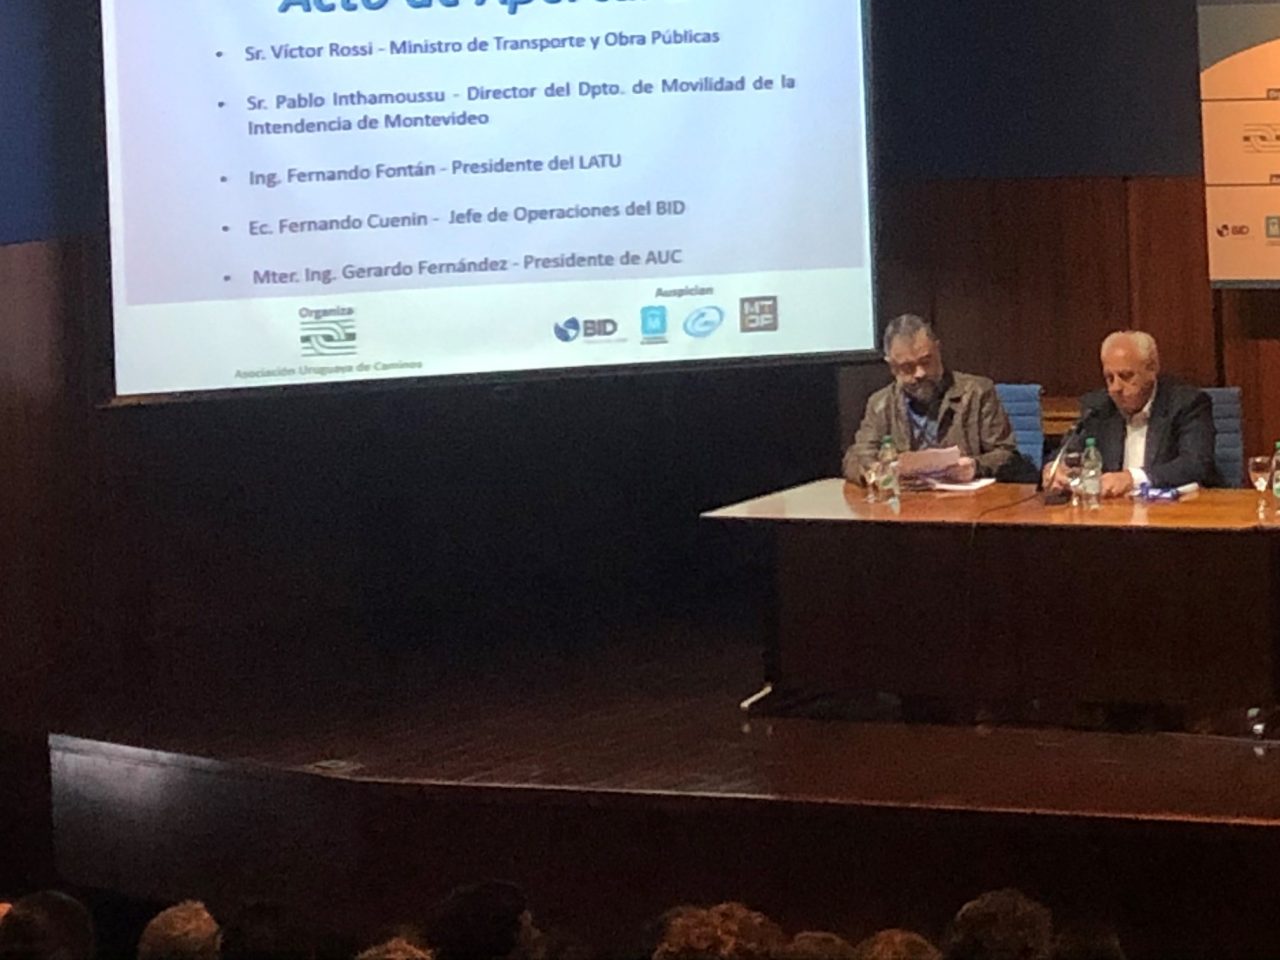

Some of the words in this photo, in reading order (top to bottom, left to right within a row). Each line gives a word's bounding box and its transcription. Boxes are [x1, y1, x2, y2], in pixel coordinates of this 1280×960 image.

[244, 45, 267, 62] Sr.
[328, 41, 374, 57] Rossi
[389, 38, 463, 55] Ministro
[467, 36, 489, 53] de
[494, 34, 587, 52] Transporte
[590, 35, 600, 50] y
[604, 31, 647, 47] Obra
[651, 29, 720, 45] Públicas
[246, 94, 268, 111] Sr.
[275, 91, 326, 110] Pablo
[332, 89, 446, 107] Inthamoussu
[467, 84, 537, 101] Director
[543, 81, 571, 98] del
[577, 80, 626, 100] Dpto.
[631, 78, 654, 95] de
[661, 75, 746, 94] Movilidad
[751, 75, 774, 91] de
[780, 74, 796, 90] la
[248, 116, 353, 136] Intendencia
[357, 114, 380, 131] de
[383, 110, 490, 129] Montevideo
[249, 170, 282, 188] Ing.
[287, 164, 371, 183] Fernando
[375, 161, 436, 179] Fontán
[451, 157, 543, 175] Presidente
[547, 155, 574, 171] del
[579, 153, 622, 170] LATU
[248, 220, 274, 236] Ec.
[278, 214, 363, 234] Fernando
[366, 211, 429, 229] Cuenin
[448, 207, 482, 224] Jefe
[486, 206, 509, 223] de
[513, 203, 621, 224] Operaciones
[624, 200, 652, 216] del
[655, 199, 686, 216] BID
[252, 269, 300, 285] Mter.
[304, 267, 337, 286] Ing.
[341, 261, 414, 280] Gerardo
[417, 256, 509, 276] Fernández
[523, 252, 615, 270] Presidente
[619, 249, 641, 266] de
[644, 248, 683, 266] AUC
[654, 285, 715, 299] Auspician
[298, 305, 355, 320] Organiza
[582, 317, 619, 338] BID
[373, 359, 424, 372] Caminos
